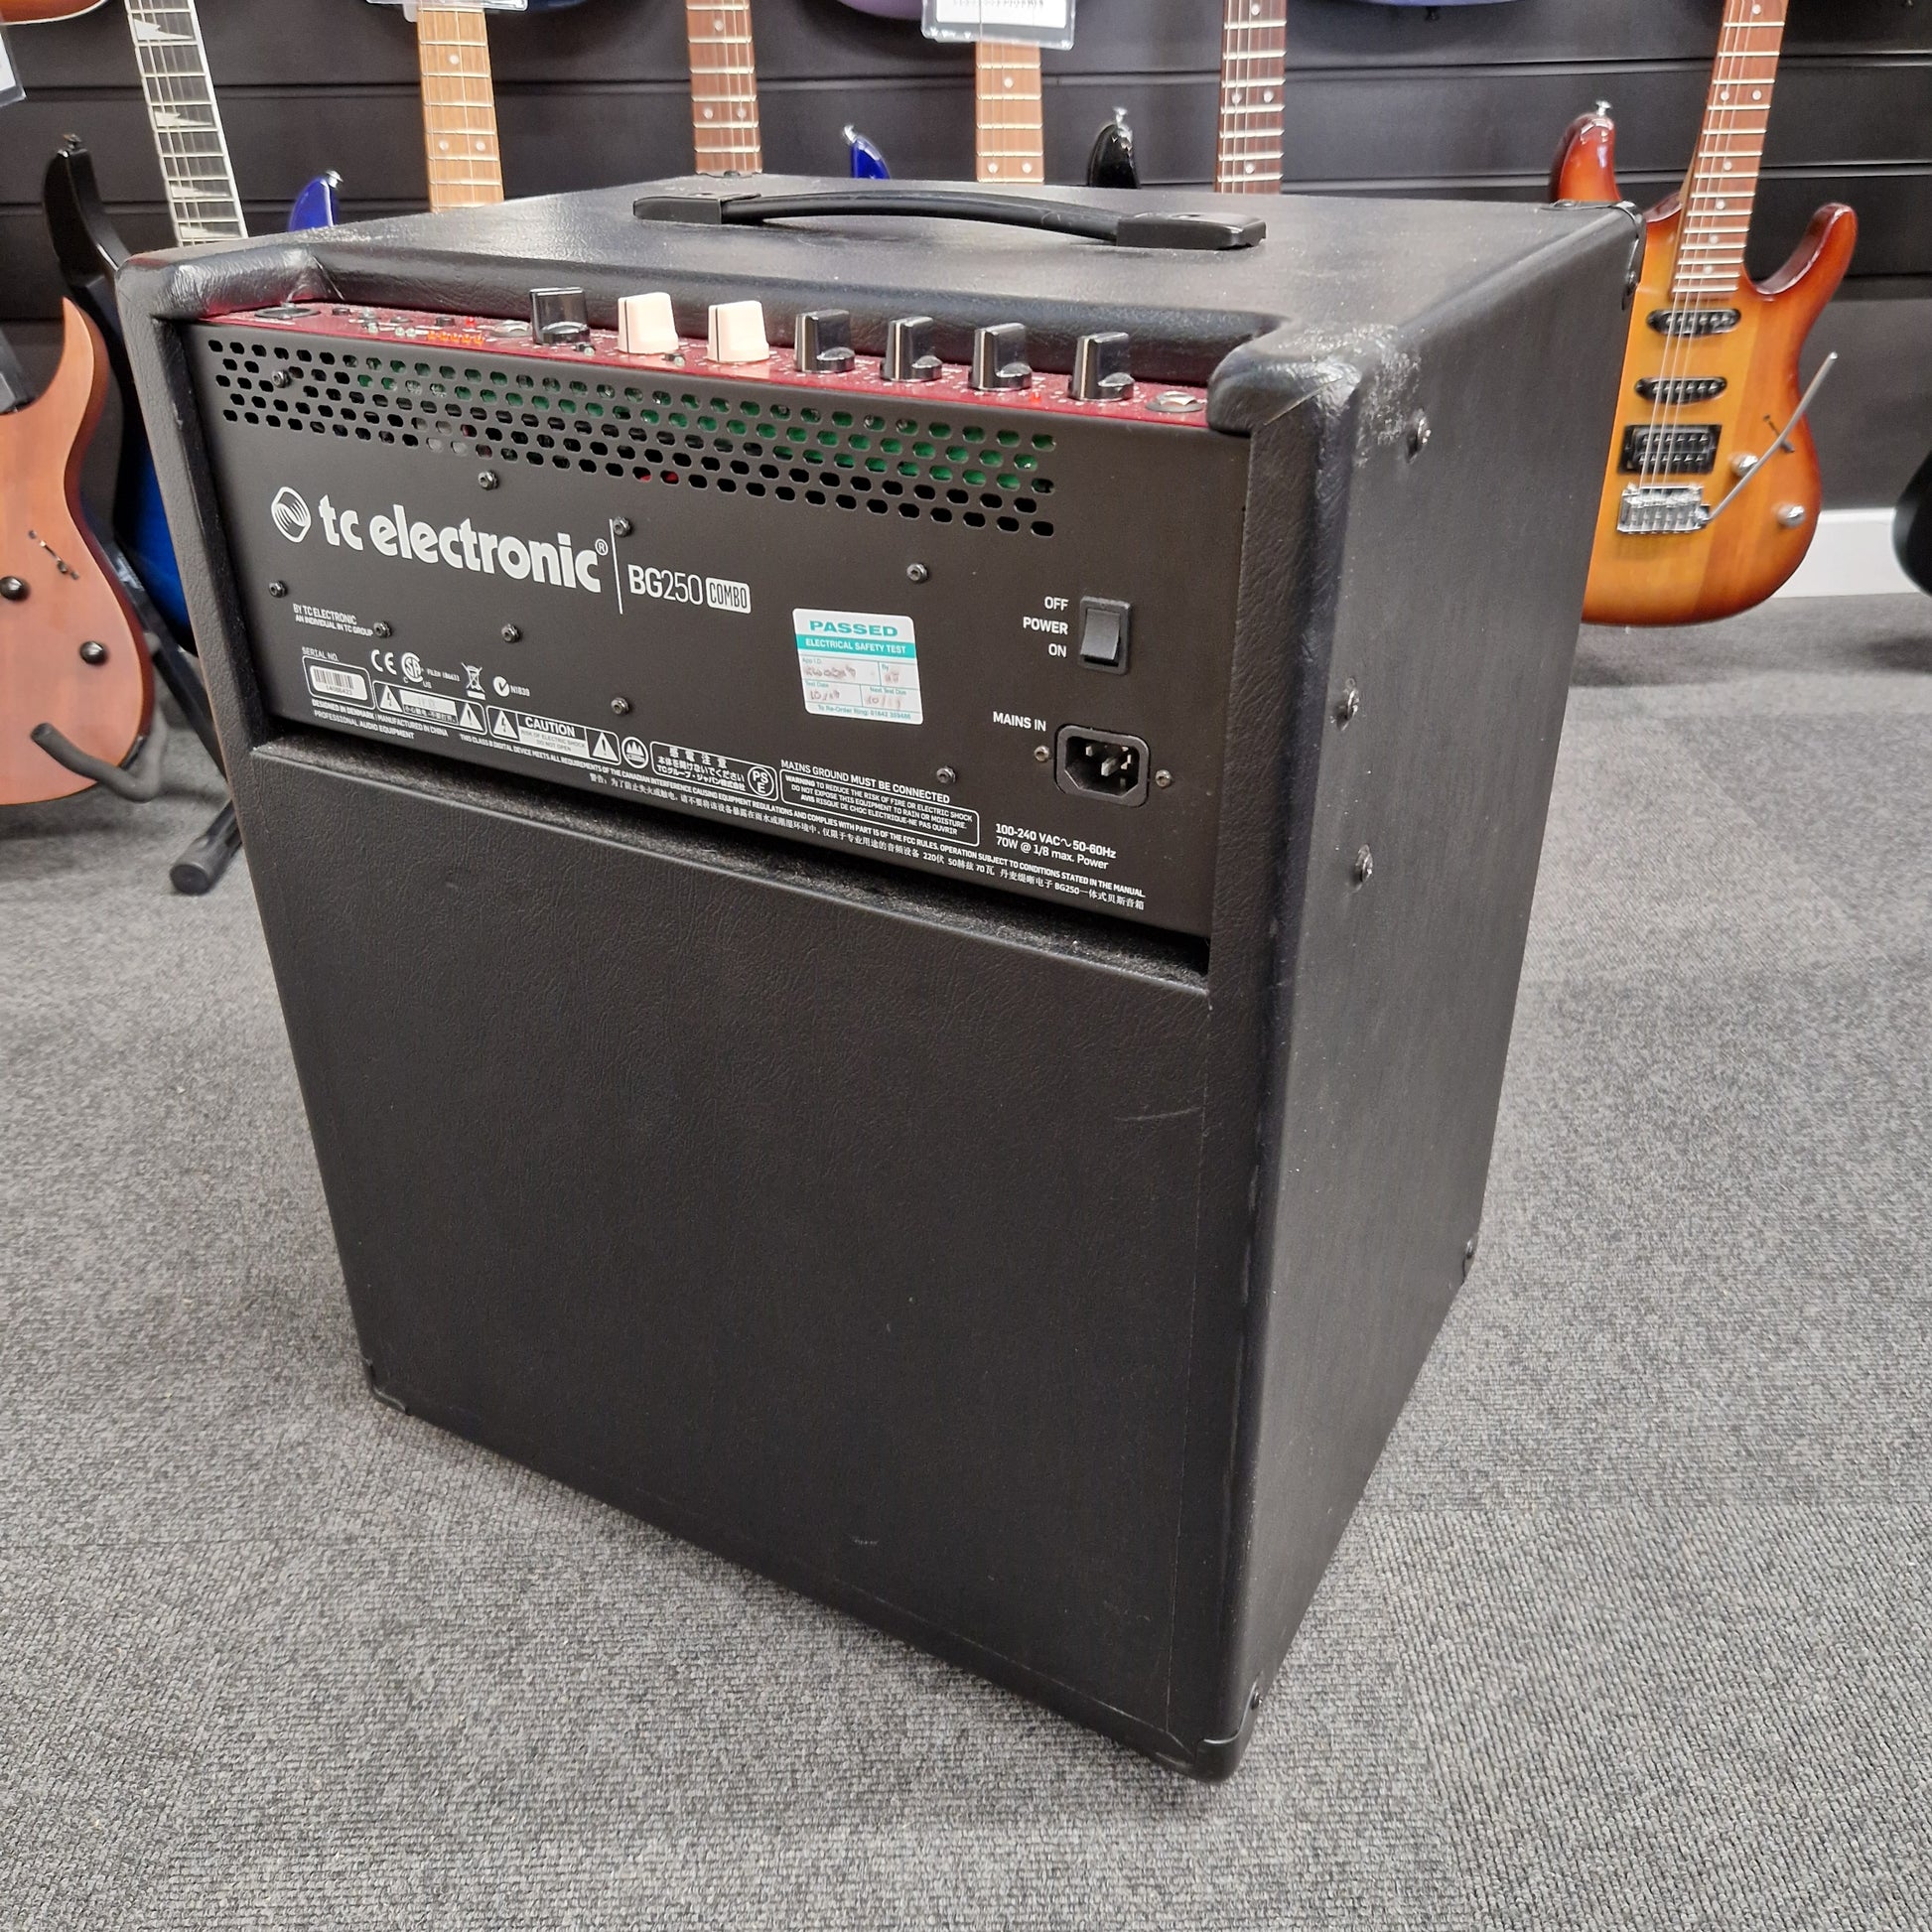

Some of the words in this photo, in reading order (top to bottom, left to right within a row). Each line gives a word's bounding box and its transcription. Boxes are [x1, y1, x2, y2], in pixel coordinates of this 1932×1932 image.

[319, 494, 363, 551] tc
[627, 564, 703, 606] BG250
[708, 580, 749, 610] COMBO
[293, 603, 303, 614] BY
[303, 605, 313, 616] TC
[313, 608, 357, 625] ELECTRONIC
[1044, 596, 1069, 611] OFF
[295, 614, 304, 623] AN
[305, 617, 337, 629] INDIVIDUAL
[352, 626, 373, 636] GROUP
[809, 620, 898, 636] PASSED
[1023, 616, 1068, 635] POWER
[302, 646, 327, 659] SERIAL
[328, 651, 340, 662] NO.
[805, 637, 853, 650] ELECTRICAL
[855, 641, 885, 653] SAFETY
[886, 644, 906, 654] TEST
[1048, 643, 1067, 657] ON
[312, 698, 340, 713] DESIGNED
[340, 704, 346, 715] IN
[346, 706, 374, 721] DENMARK
[314, 709, 358, 728] PROFESSIONAL
[359, 720, 378, 733] AUDIO
[378, 724, 415, 741] EQUIPMENT
[377, 713, 423, 732] MANUFACTURED
[423, 723, 430, 734] IN
[430, 725, 449, 738] CHINA
[525, 717, 576, 738] CAUTION
[993, 711, 1032, 729] MAINS
[1035, 719, 1046, 732] IN
[541, 734, 566, 745] ELECTRIC
[567, 740, 586, 749] SHOCK
[556, 743, 571, 752] OPEN
[780, 759, 811, 774] MAINS
[812, 766, 850, 782] GROUND
[850, 773, 877, 788] MUST
[878, 780, 892, 791] BE
[893, 783, 950, 804] CONNECTED
[785, 774, 816, 787] WARNING
[825, 783, 850, 795] REDUCE
[850, 788, 864, 798] THE
[864, 791, 880, 802] RISK
[890, 797, 906, 807] FIRE
[916, 802, 949, 817] ELECTRIC
[950, 810, 973, 822] SHOCK
[791, 783, 800, 792] DO
[801, 785, 814, 795] NOT
[814, 788, 839, 801] EXPOSE
[839, 793, 855, 804] THIS
[855, 796, 893, 812] EQUIPMENT
[893, 805, 901, 814] TO
[902, 807, 919, 818] RAIN
[930, 814, 967, 830] MOISTURE.
[460, 732, 472, 743] THIS
[472, 735, 488, 747] CLASS
[492, 740, 513, 753] DIGITAL
[512, 745, 532, 757] DEVICE
[532, 749, 550, 760] MEETS
[550, 753, 561, 763] ALL
[560, 756, 602, 772] REQUIREMENTS
[601, 764, 610, 774] OF
[610, 766, 621, 777] THE
[621, 769, 650, 783] CANADIAN
[650, 775, 693, 793] INTERFERENCE
[692, 785, 717, 799] CAUSING
[718, 791, 752, 806] EQUIPMENT
[794, 808, 806, 819] AND
[806, 811, 837, 826] COMPLIES
[838, 819, 854, 830] WITH
[855, 823, 872, 834] PART
[872, 826, 879, 836] 15
[880, 828, 889, 838] OF
[890, 830, 902, 841] THE
[902, 834, 915, 844] FCC
[915, 837, 939, 850] RULES.
[939, 842, 977, 858] OPERATION
[977, 851, 1008, 865] SUBJECT
[1009, 858, 1018, 868] TO
[1019, 860, 1060, 878] CONDITIONS
[1060, 870, 1088, 884] STATED
[1089, 876, 1097, 886] IN
[1098, 878, 1112, 889] THE
[800, 793, 815, 803] AVIS
[815, 796, 840, 809] RISQUE
[840, 802, 849, 811] DE
[849, 804, 868, 815] CHOC
[918, 820, 931, 830] PAS
[932, 823, 958, 836] OUVRIR
[995, 823, 1037, 842] 100-240
[1072, 840, 1117, 859] 50-60Hz
[996, 836, 1019, 850] 70W
[1020, 843, 1033, 854] @
[1034, 844, 1049, 857] 1/8
[1051, 849, 1075, 863] max.
[1076, 853, 1109, 870] Power
